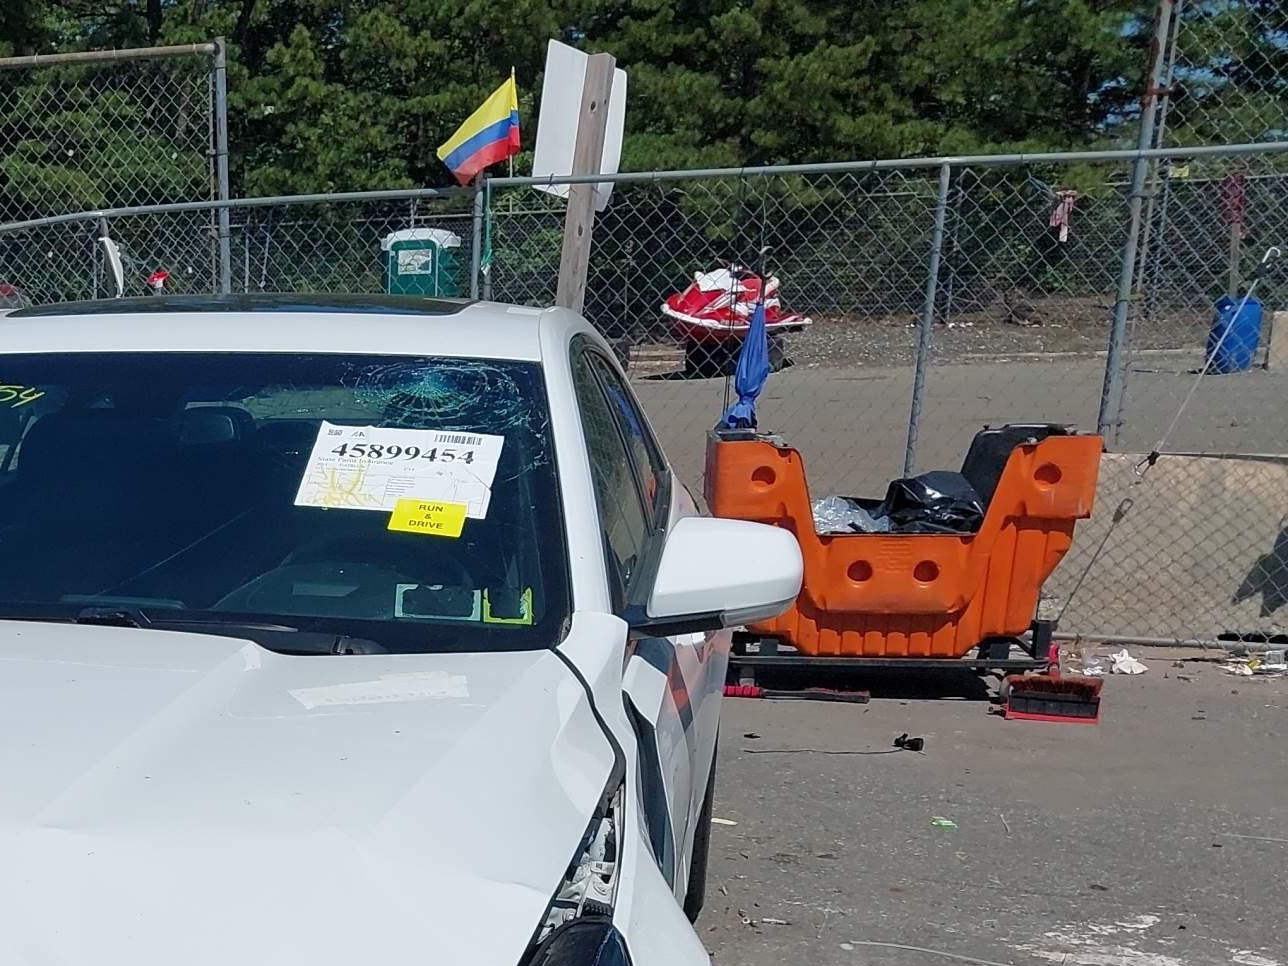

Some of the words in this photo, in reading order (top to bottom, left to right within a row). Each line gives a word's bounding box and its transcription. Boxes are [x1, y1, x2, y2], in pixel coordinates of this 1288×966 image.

[331, 442, 475, 465] 45899454
[418, 504, 444, 513] RUN
[408, 519, 444, 529] DRIVE
